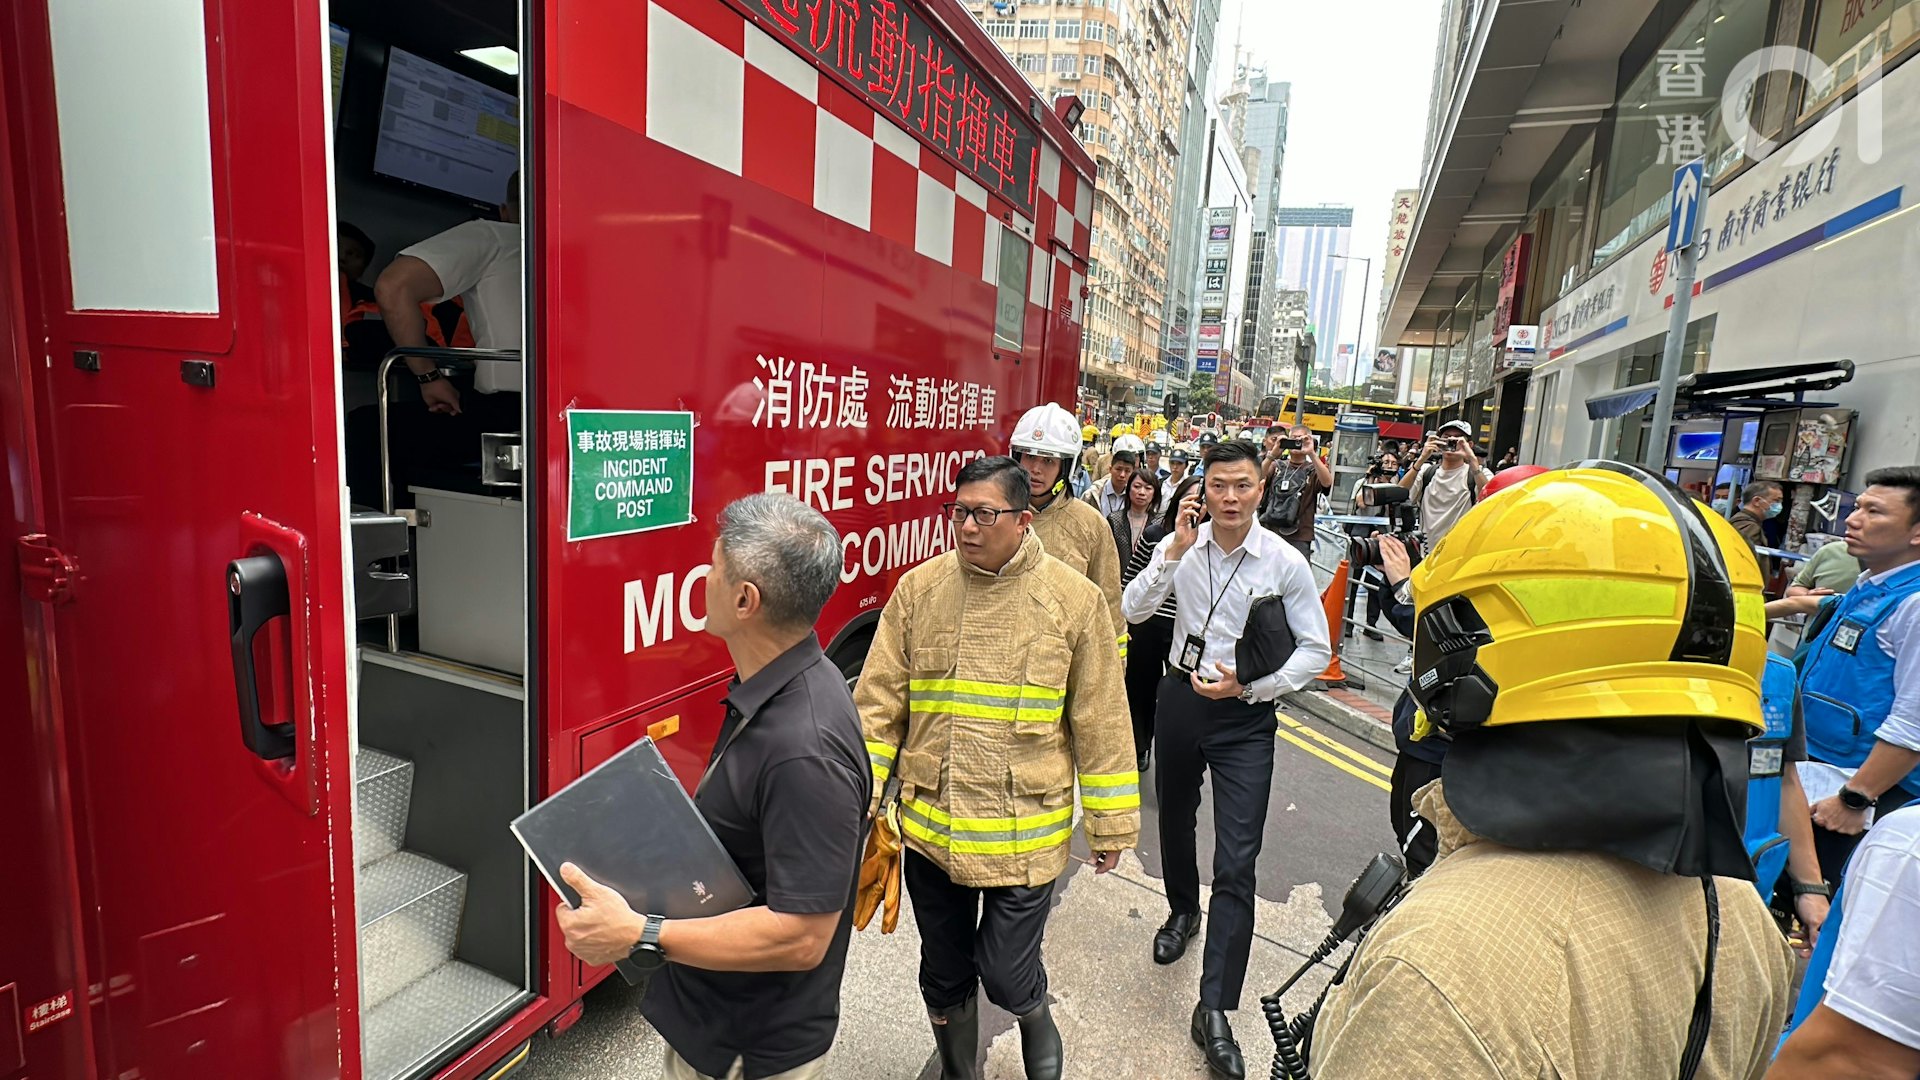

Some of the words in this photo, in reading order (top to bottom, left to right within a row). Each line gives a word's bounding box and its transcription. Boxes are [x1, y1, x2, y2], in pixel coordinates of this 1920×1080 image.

[762, 0, 1018, 190] 流動指揮車
[1717, 147, 1841, 251] 南洋商業銀行
[751, 353, 870, 430] 消防處
[886, 373, 997, 431] 流動指揮車
[577, 429, 687, 453] 事故現場指揮站
[603, 458, 668, 479] INCIDENT
[595, 477, 673, 501] COMMAND
[764, 456, 856, 513] FIRE
[617, 499, 654, 520] POST
[1420, 670, 1437, 686] MSA
[32, 994, 68, 1019] 樓梯
[30, 1008, 71, 1031] Staircase
